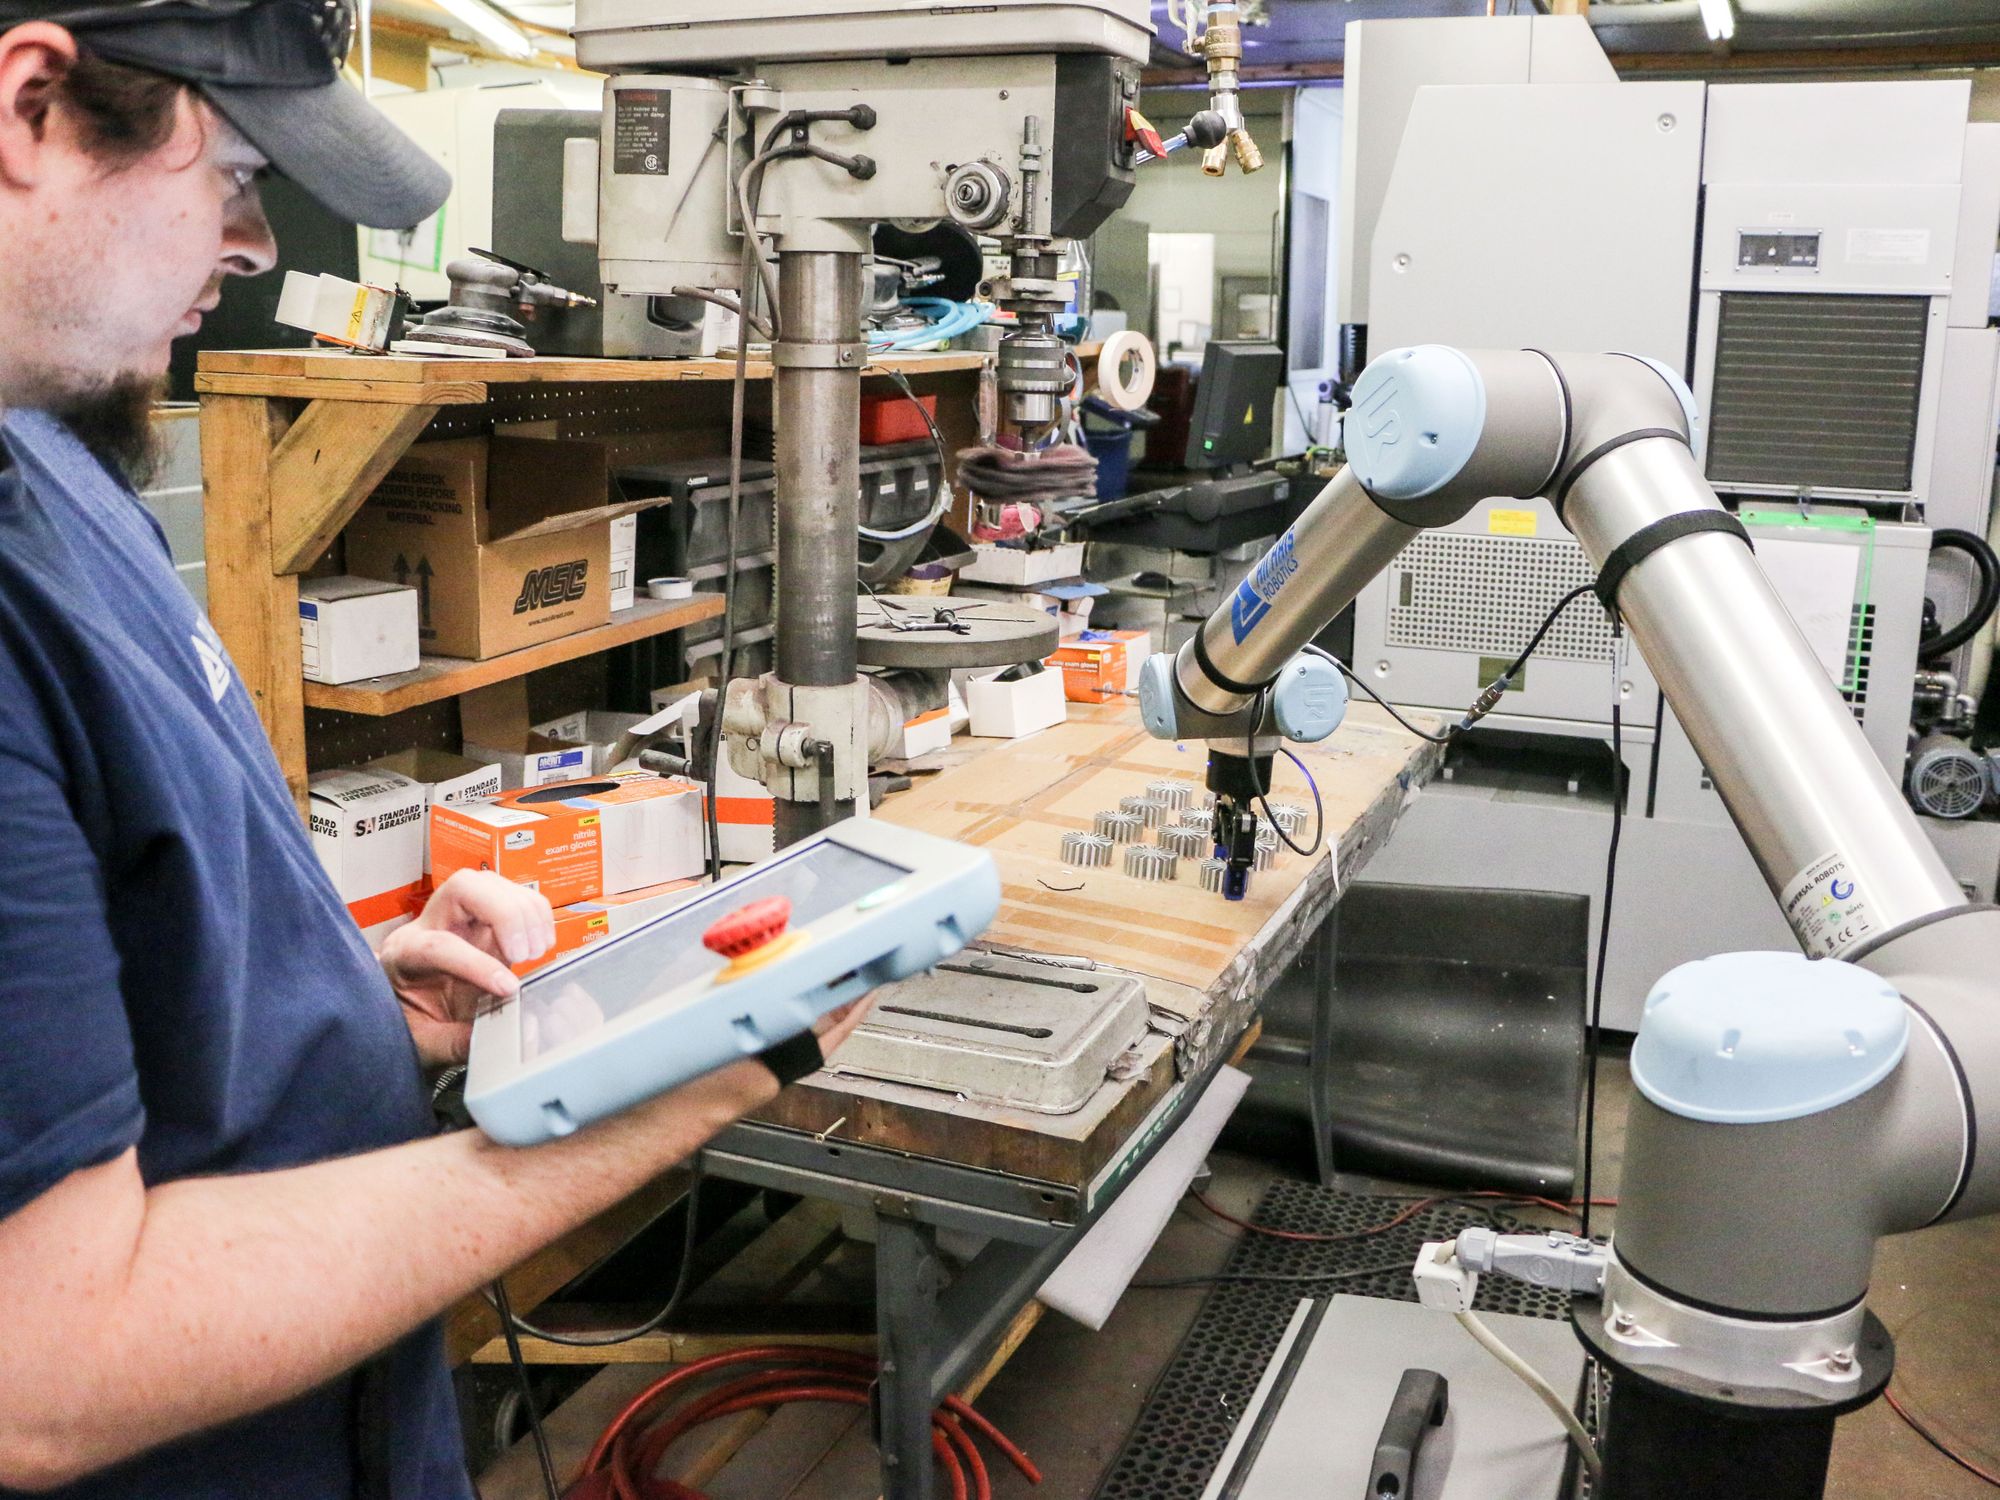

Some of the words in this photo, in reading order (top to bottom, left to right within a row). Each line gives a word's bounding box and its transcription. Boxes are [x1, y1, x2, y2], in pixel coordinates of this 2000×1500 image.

[513, 559, 588, 615] MSC
[1262, 556, 1299, 601] ROBOTICS
[342, 786, 388, 801] STANDARD
[464, 777, 498, 795] STANDARD
[378, 804, 421, 823] STANDARD
[378, 812, 422, 831] ABRASIVES
[573, 828, 597, 841] nitrile
[545, 845, 569, 856] exam
[570, 839, 598, 852] gloves
[1814, 861, 1845, 884] ROBOTS
